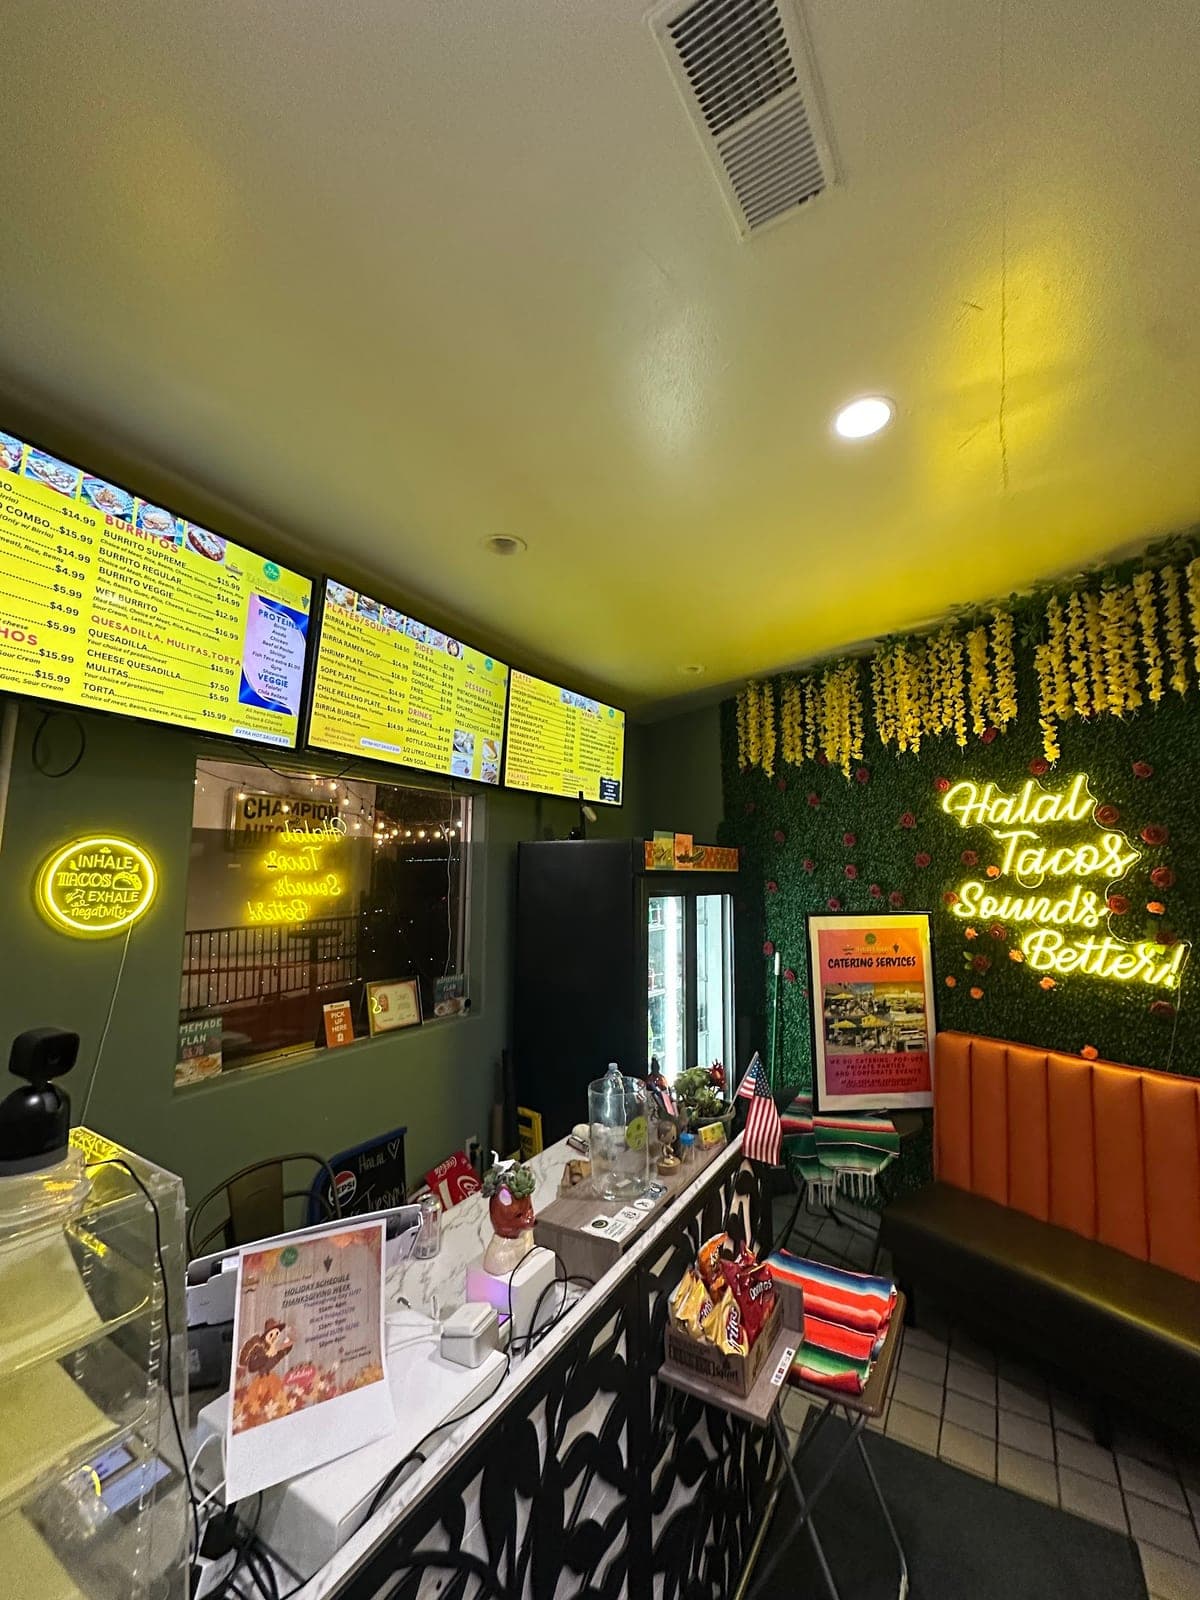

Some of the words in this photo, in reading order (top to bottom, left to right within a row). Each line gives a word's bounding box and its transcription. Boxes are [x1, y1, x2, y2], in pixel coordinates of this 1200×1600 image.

[62, 507, 96, 527] $14.99
[6, 506, 50, 528] COMBO
[59, 526, 93, 545] $15.99
[104, 514, 179, 554] BURRITOS
[56, 545, 91, 564] $14.99
[104, 529, 145, 552] BURRITO
[146, 547, 187, 569] SUPREME
[55, 564, 85, 581] $4.99
[99, 547, 140, 568] BURRITO
[142, 564, 183, 585] REGULAR
[99, 566, 140, 587] BURRITO
[142, 582, 174, 600] VEGGIE
[53, 584, 82, 599] $5.99
[95, 586, 116, 599] WET
[119, 594, 158, 614] BURRITO
[50, 602, 80, 616] $4.99
[46, 620, 76, 634] $5.99
[88, 628, 148, 651] QUESADILLA
[323, 632, 343, 646] BIRRIA
[39, 648, 74, 664] $15.99
[320, 647, 344, 658] SHRIMP
[346, 656, 363, 666] PLATE
[35, 669, 70, 684] $15.99
[86, 662, 128, 678] MULITAS
[87, 649, 124, 665] CHEESE
[127, 660, 181, 680] QUESADILLA
[210, 681, 230, 692] $7.50
[258, 673, 288, 688] VEGGIE
[83, 682, 116, 696] TORTA
[317, 684, 337, 695] CHILE
[316, 702, 336, 714] BIRRIA
[337, 708, 360, 720] BURGER
[942, 774, 1095, 826] Halal
[244, 798, 339, 820] CHAMPION
[78, 854, 134, 870] INHALE
[994, 830, 1140, 878] Tacos
[57, 872, 112, 888] TACOS
[88, 890, 140, 903] EXHALE
[72, 904, 127, 920] negativity
[954, 882, 1110, 928] Sounds
[828, 957, 874, 969] CATERING
[876, 956, 916, 968] SERVICES
[1023, 929, 1186, 990] Better!
[331, 1011, 346, 1019] PICK
[332, 1024, 348, 1032] HERE
[181, 1034, 207, 1047] FLAN
[284, 1282, 315, 1297] HOLIDAY
[316, 1273, 350, 1289] SCHEDULE
[332, 1284, 351, 1294] WEEK
